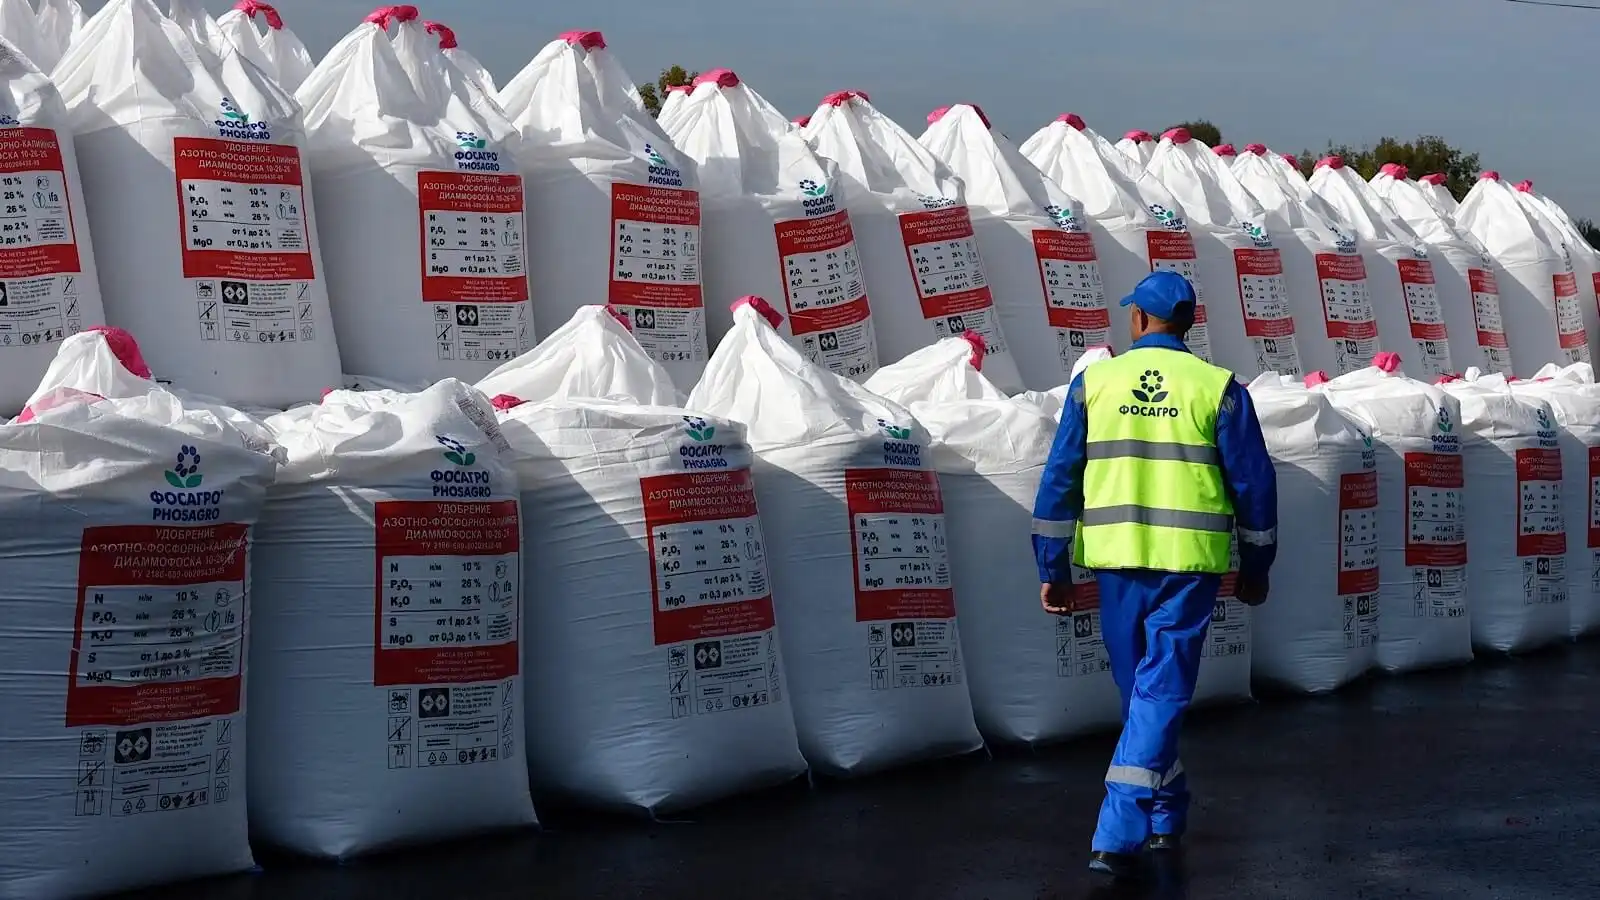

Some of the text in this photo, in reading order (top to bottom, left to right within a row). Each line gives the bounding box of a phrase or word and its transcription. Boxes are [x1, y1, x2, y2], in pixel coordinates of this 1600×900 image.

[220, 129, 270, 140] PHOSAGRO
[225, 142, 270, 153] УДОБРЕНИЕ
[0, 151, 18, 160] СКА
[455, 151, 497, 161] ФОСАГРО
[199, 159, 263, 172] ДИАММОФОСКА
[458, 162, 500, 171] PHOSAGRO
[462, 174, 501, 183] УДОБРЕНИЕ
[648, 176, 683, 187] PHOSAGRO
[4, 191, 14, 200] 26
[439, 191, 494, 202] ДИАММОФОСКА
[6, 205, 17, 213] 26
[252, 213, 261, 221] 26
[194, 239, 212, 248] MgO
[237, 239, 248, 248] 0,3
[432, 266, 448, 274] MgO
[1119, 405, 1180, 418] ФОСАГРО
[680, 445, 723, 457] ФОСАГРО
[683, 459, 727, 469] PHOSAGRO
[431, 470, 489, 484] ФОСАГРО
[690, 473, 731, 483] УДОБРЕНИЕ
[433, 486, 492, 498] PHOSAGRO
[150, 490, 221, 505] ФОСАГРО
[669, 497, 729, 510] ДИАММОФОСКА
[437, 504, 492, 514] УДОБРЕНИЕ
[152, 508, 219, 521] PHOSAGRO
[861, 518, 867, 527] N
[155, 528, 215, 541] УДОБРЕНИЕ
[405, 529, 482, 541] ДИАММОФОСКА
[660, 525, 727, 541] N 10
[721, 540, 729, 549] 26
[114, 555, 201, 568] ДИАММОФОСКА
[723, 555, 731, 564] 26
[391, 562, 398, 572] N
[463, 562, 472, 571] 10
[865, 563, 870, 571] S
[461, 579, 471, 588] 26
[666, 581, 671, 589] S
[95, 590, 199, 604] N 10 %
[461, 596, 471, 605] 26
[666, 595, 685, 606] MgO
[710, 591, 720, 601] 0,3
[723, 590, 731, 598] до
[172, 610, 184, 620] 26
[390, 617, 397, 627] S
[455, 618, 465, 626] до
[170, 627, 183, 637] 26
[390, 635, 413, 645] MgO
[442, 633, 454, 643] 0,3
[456, 634, 466, 642] до
[141, 653, 151, 661] от
[161, 652, 172, 662] до
[160, 668, 172, 678] до
